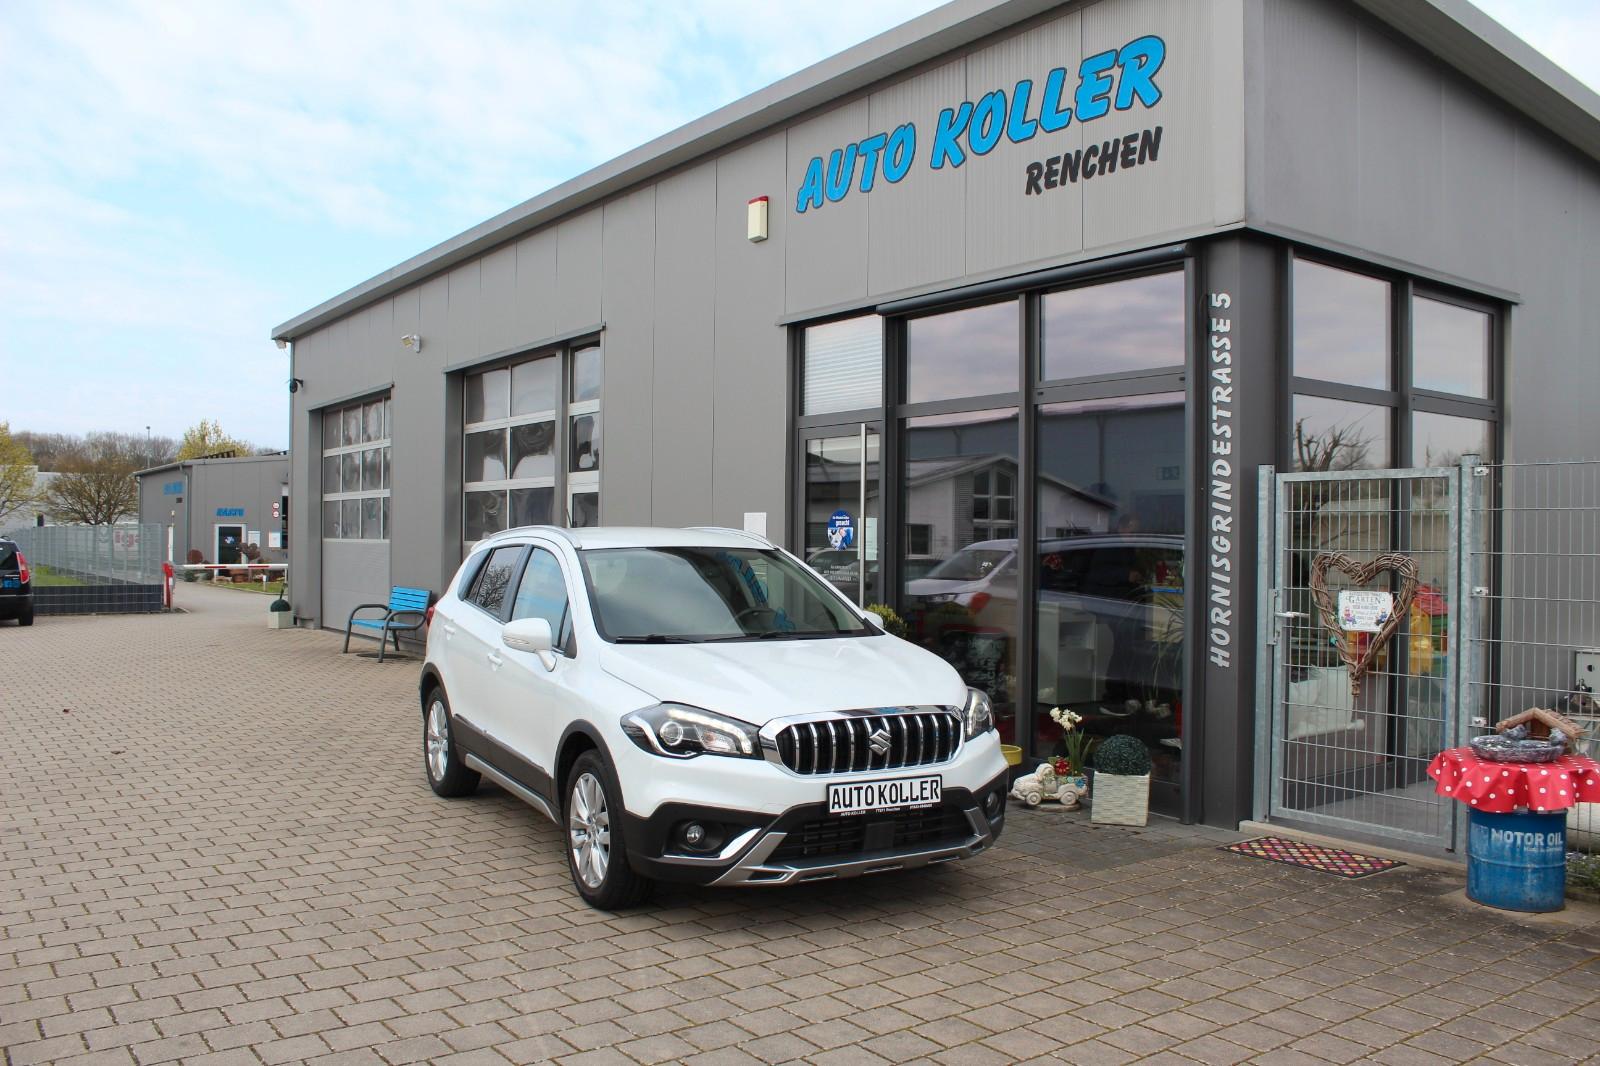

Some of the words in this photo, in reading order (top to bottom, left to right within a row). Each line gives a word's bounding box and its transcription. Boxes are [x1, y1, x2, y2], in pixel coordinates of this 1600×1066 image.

[796, 122, 916, 213] AUTO
[929, 35, 1166, 169] KOLLER
[1025, 126, 1163, 195] RENCHEN
[1211, 292, 1231, 309] 5
[1210, 318, 1232, 668] HORNISGRINDESTRASSE
[831, 785, 874, 810] AUTO
[878, 780, 940, 806] KOLLER
[1491, 828, 1545, 847] MOTOR
[1547, 832, 1563, 847] OIL
